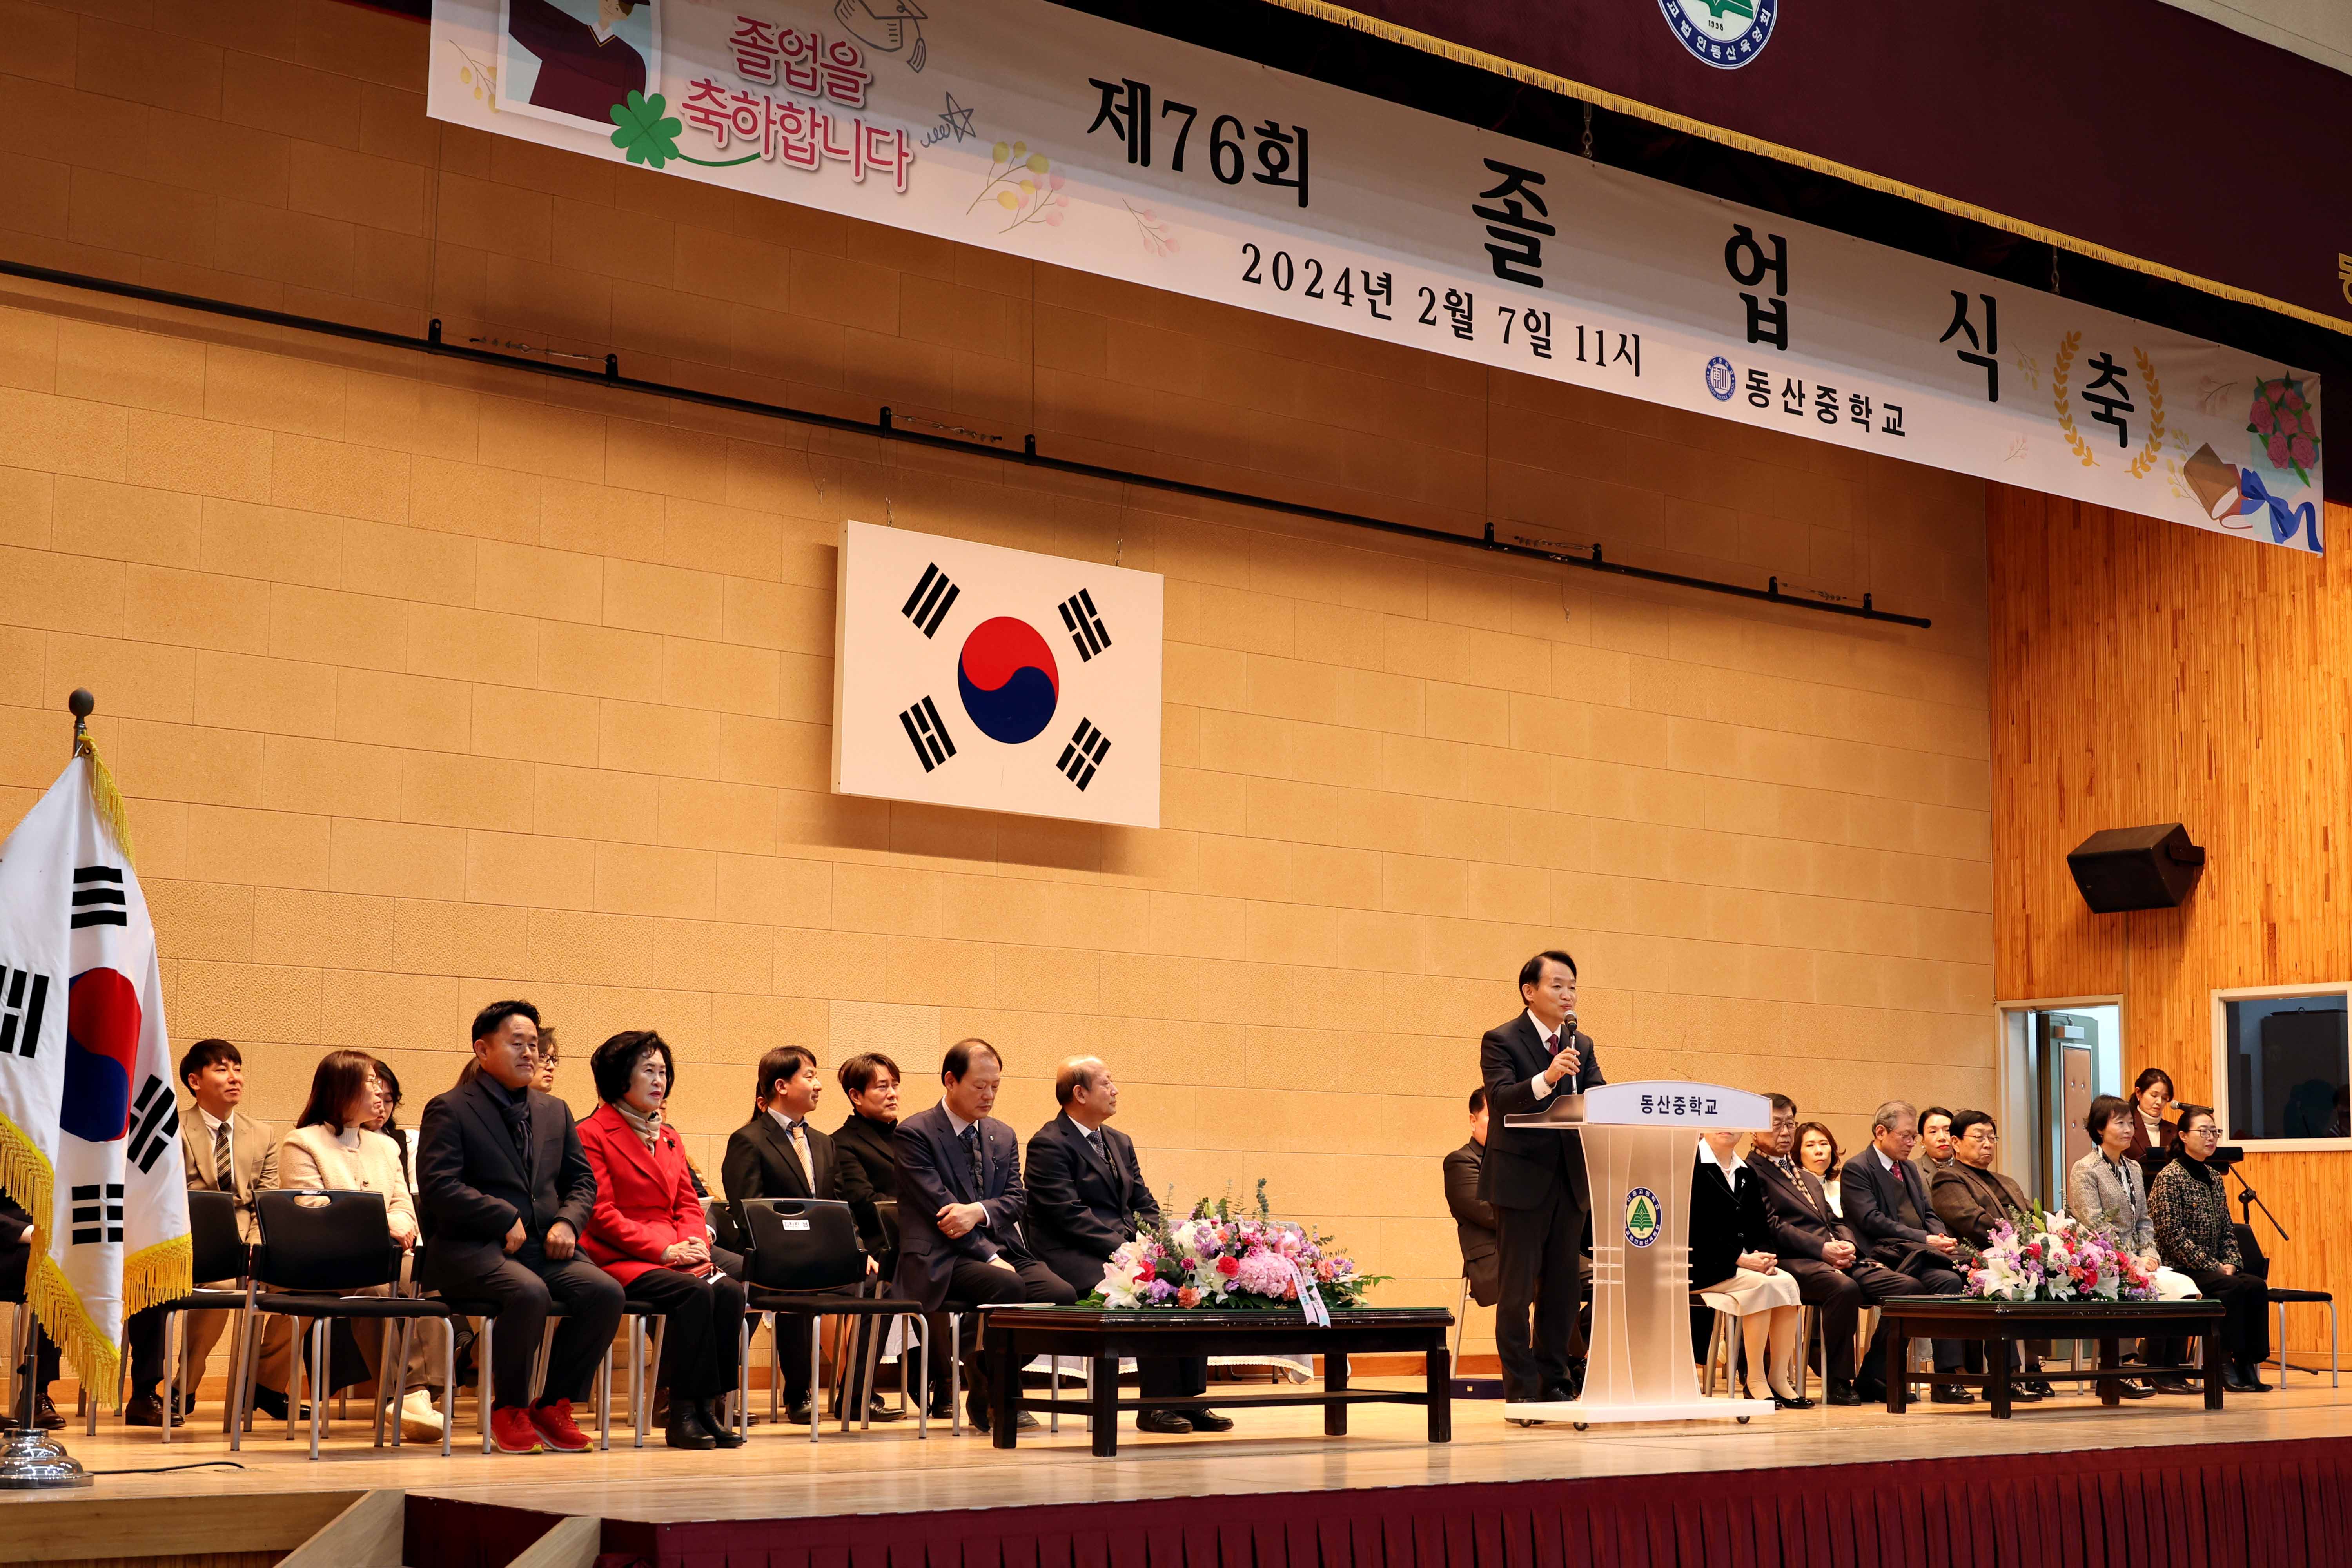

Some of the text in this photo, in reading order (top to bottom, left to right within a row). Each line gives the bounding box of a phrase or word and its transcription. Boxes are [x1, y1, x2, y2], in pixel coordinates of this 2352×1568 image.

[730, 16, 868, 103] 졸업을
[1708, 20, 1723, 31] 1938
[681, 79, 910, 188] 축하합니다
[1087, 77, 1310, 208] 제76회
[1241, 243, 1640, 377] 2024년 2월 7일 11시
[1745, 368, 1906, 437] 동산중학교
[2081, 351, 2135, 448] 축
[1641, 1094, 1718, 1116] 동산중학교
[1626, 1189, 1660, 1210] 산중고등학교
